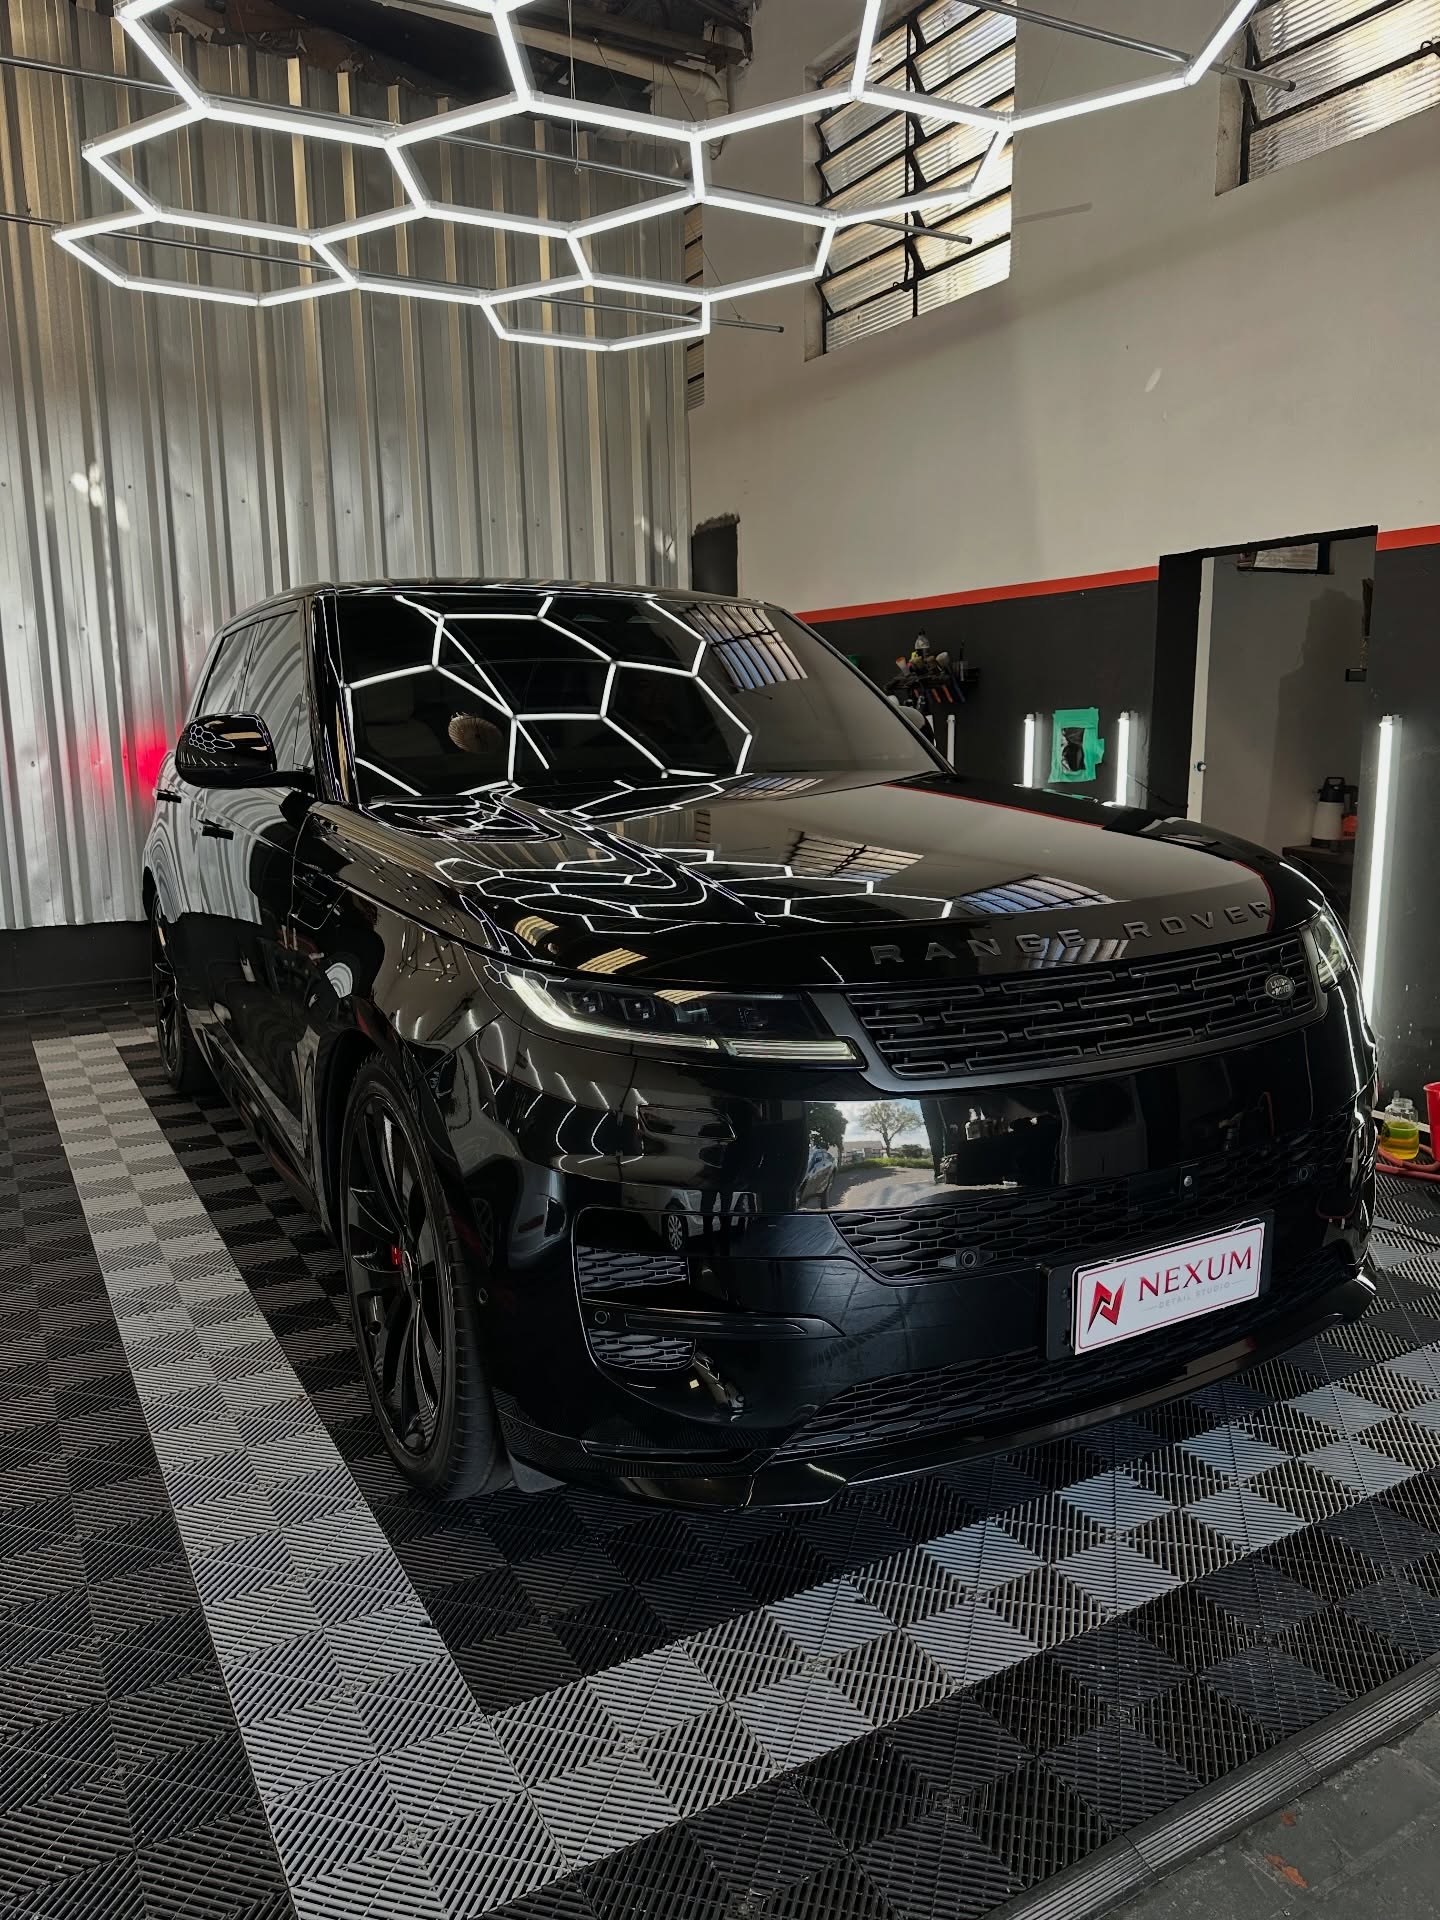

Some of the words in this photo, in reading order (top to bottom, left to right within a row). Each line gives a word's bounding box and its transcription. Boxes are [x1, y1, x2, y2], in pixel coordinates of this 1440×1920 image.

[871, 928, 1086, 965] RANGE
[1123, 901, 1273, 940] ROVER
[1138, 1246, 1252, 1301] NEXUM
[1159, 1295, 1191, 1308] DETAIL
[1196, 1282, 1230, 1297] STUDIO
